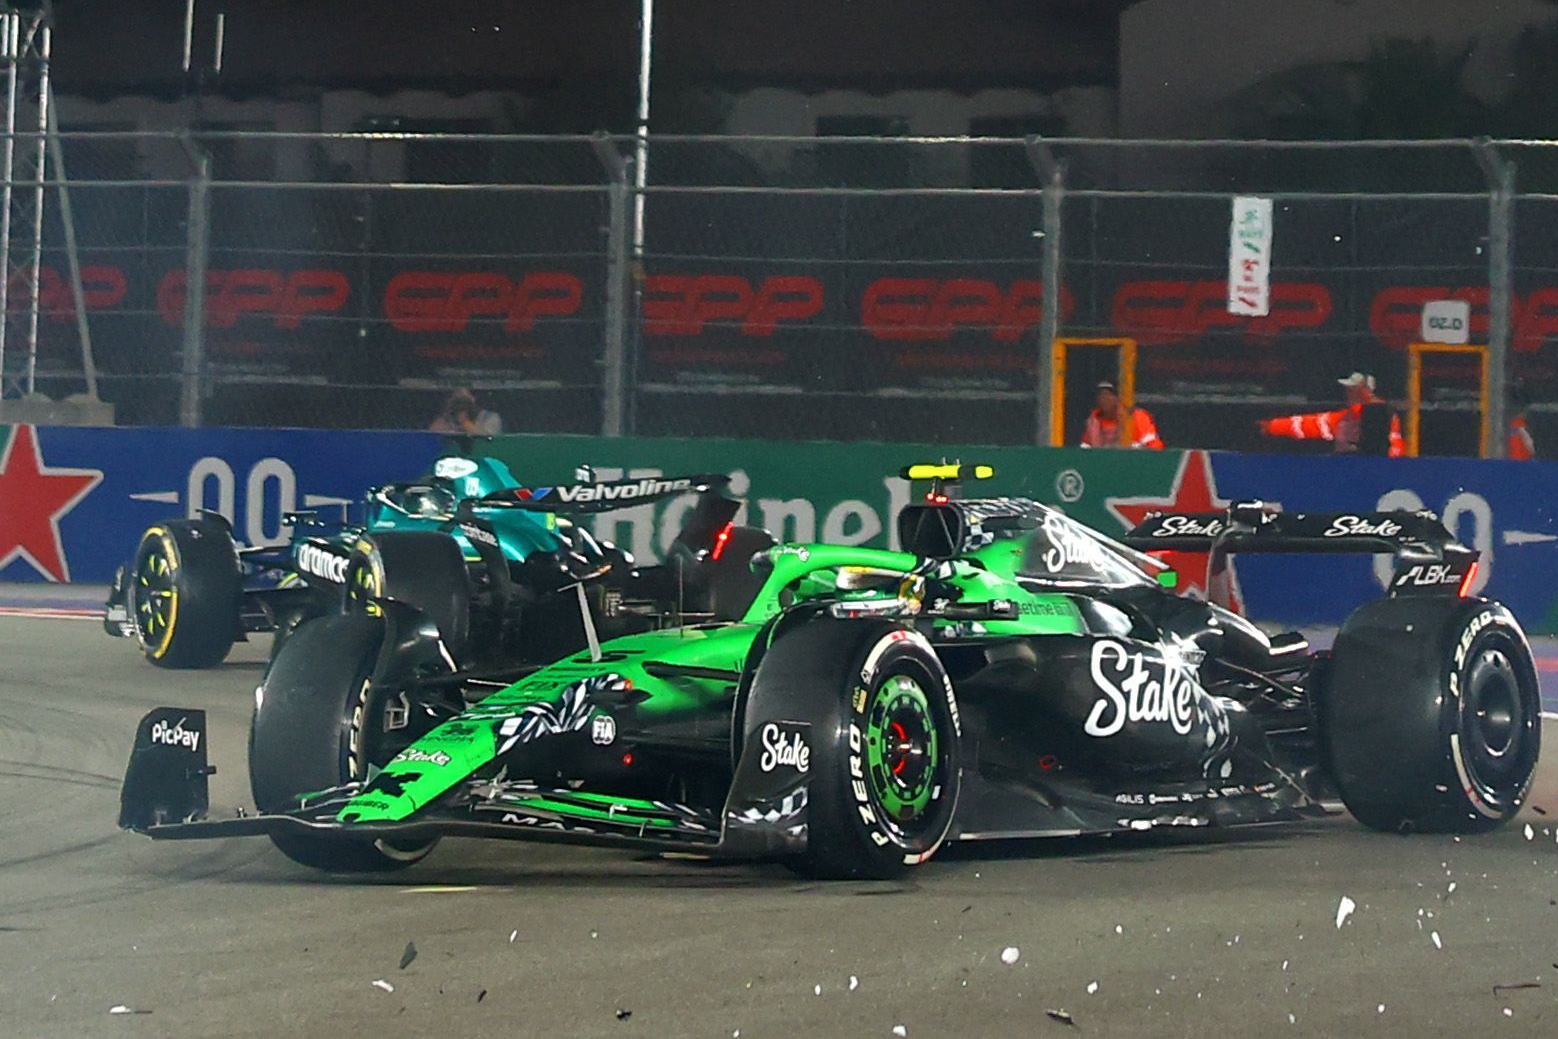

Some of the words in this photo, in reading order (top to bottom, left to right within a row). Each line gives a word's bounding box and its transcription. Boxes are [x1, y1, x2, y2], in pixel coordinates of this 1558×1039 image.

[556, 476, 691, 503] Valvoline
[1084, 639, 1198, 737] Stake
[152, 719, 200, 752] PicPay
[761, 723, 810, 772] Stake
[850, 723, 877, 826] ZERO
